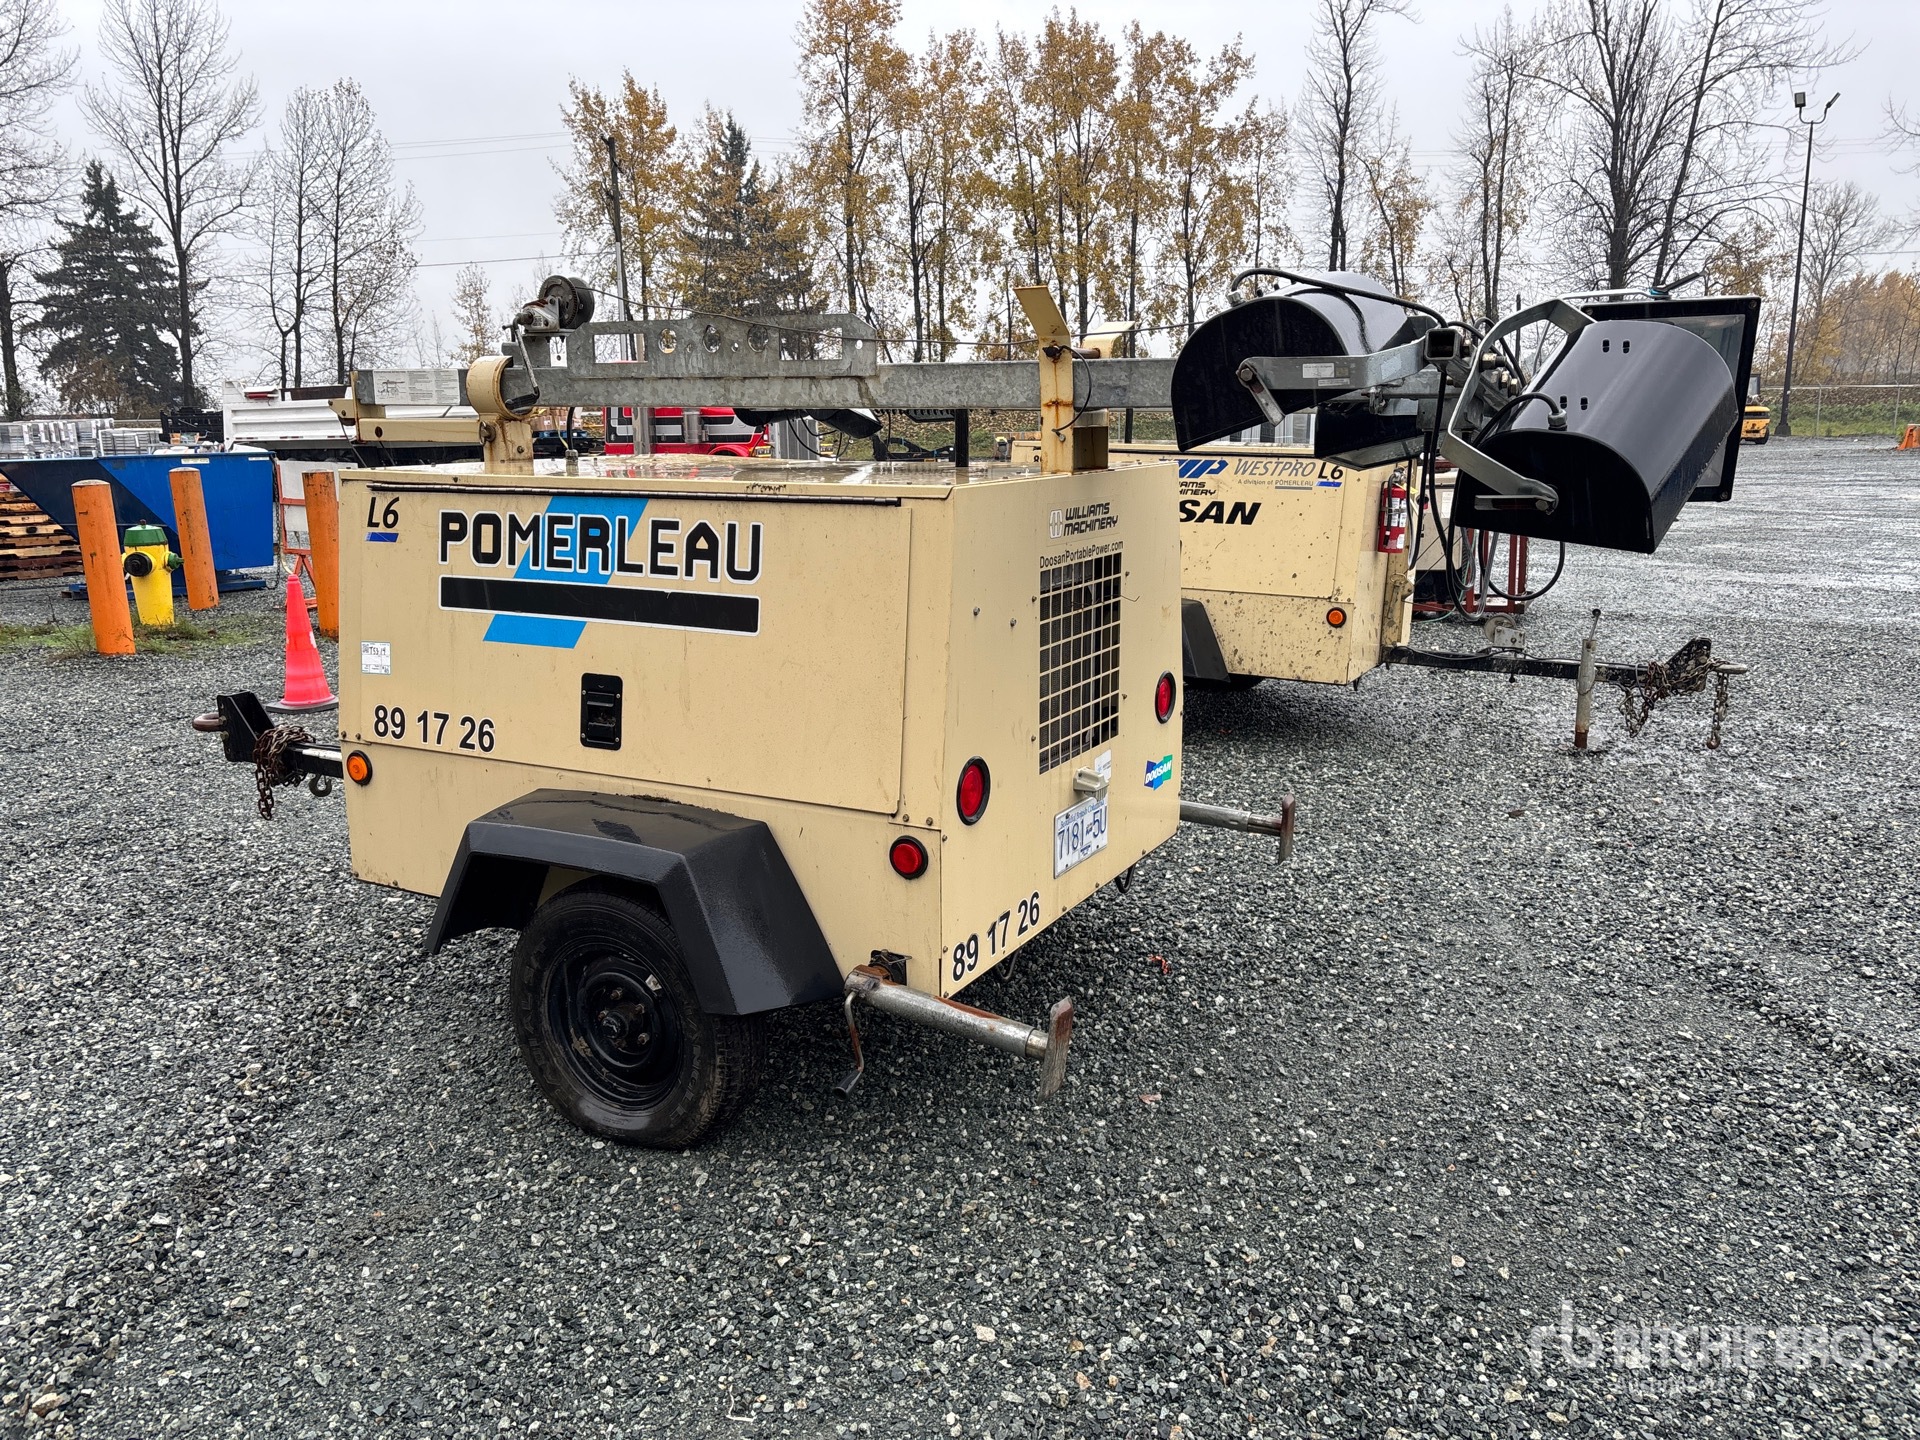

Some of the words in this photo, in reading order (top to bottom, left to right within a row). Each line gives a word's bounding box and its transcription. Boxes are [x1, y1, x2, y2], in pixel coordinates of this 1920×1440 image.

[1233, 460, 1317, 477] WESTPRO
[1318, 462, 1343, 480] L6
[1243, 478, 1265, 486] division
[366, 496, 400, 529] L6
[1065, 502, 1111, 521] WILLIAMS
[1063, 515, 1119, 537] MACHINERY
[438, 509, 764, 584] POMERLEAU
[1040, 541, 1124, 569] DoosanPortablePower.com
[373, 705, 406, 741] 89
[416, 709, 450, 747] 17
[458, 714, 496, 754] 26
[1145, 760, 1172, 784] DOOSAN
[952, 933, 979, 982] 89
[986, 909, 1011, 956] 17
[1016, 890, 1040, 937] 26
